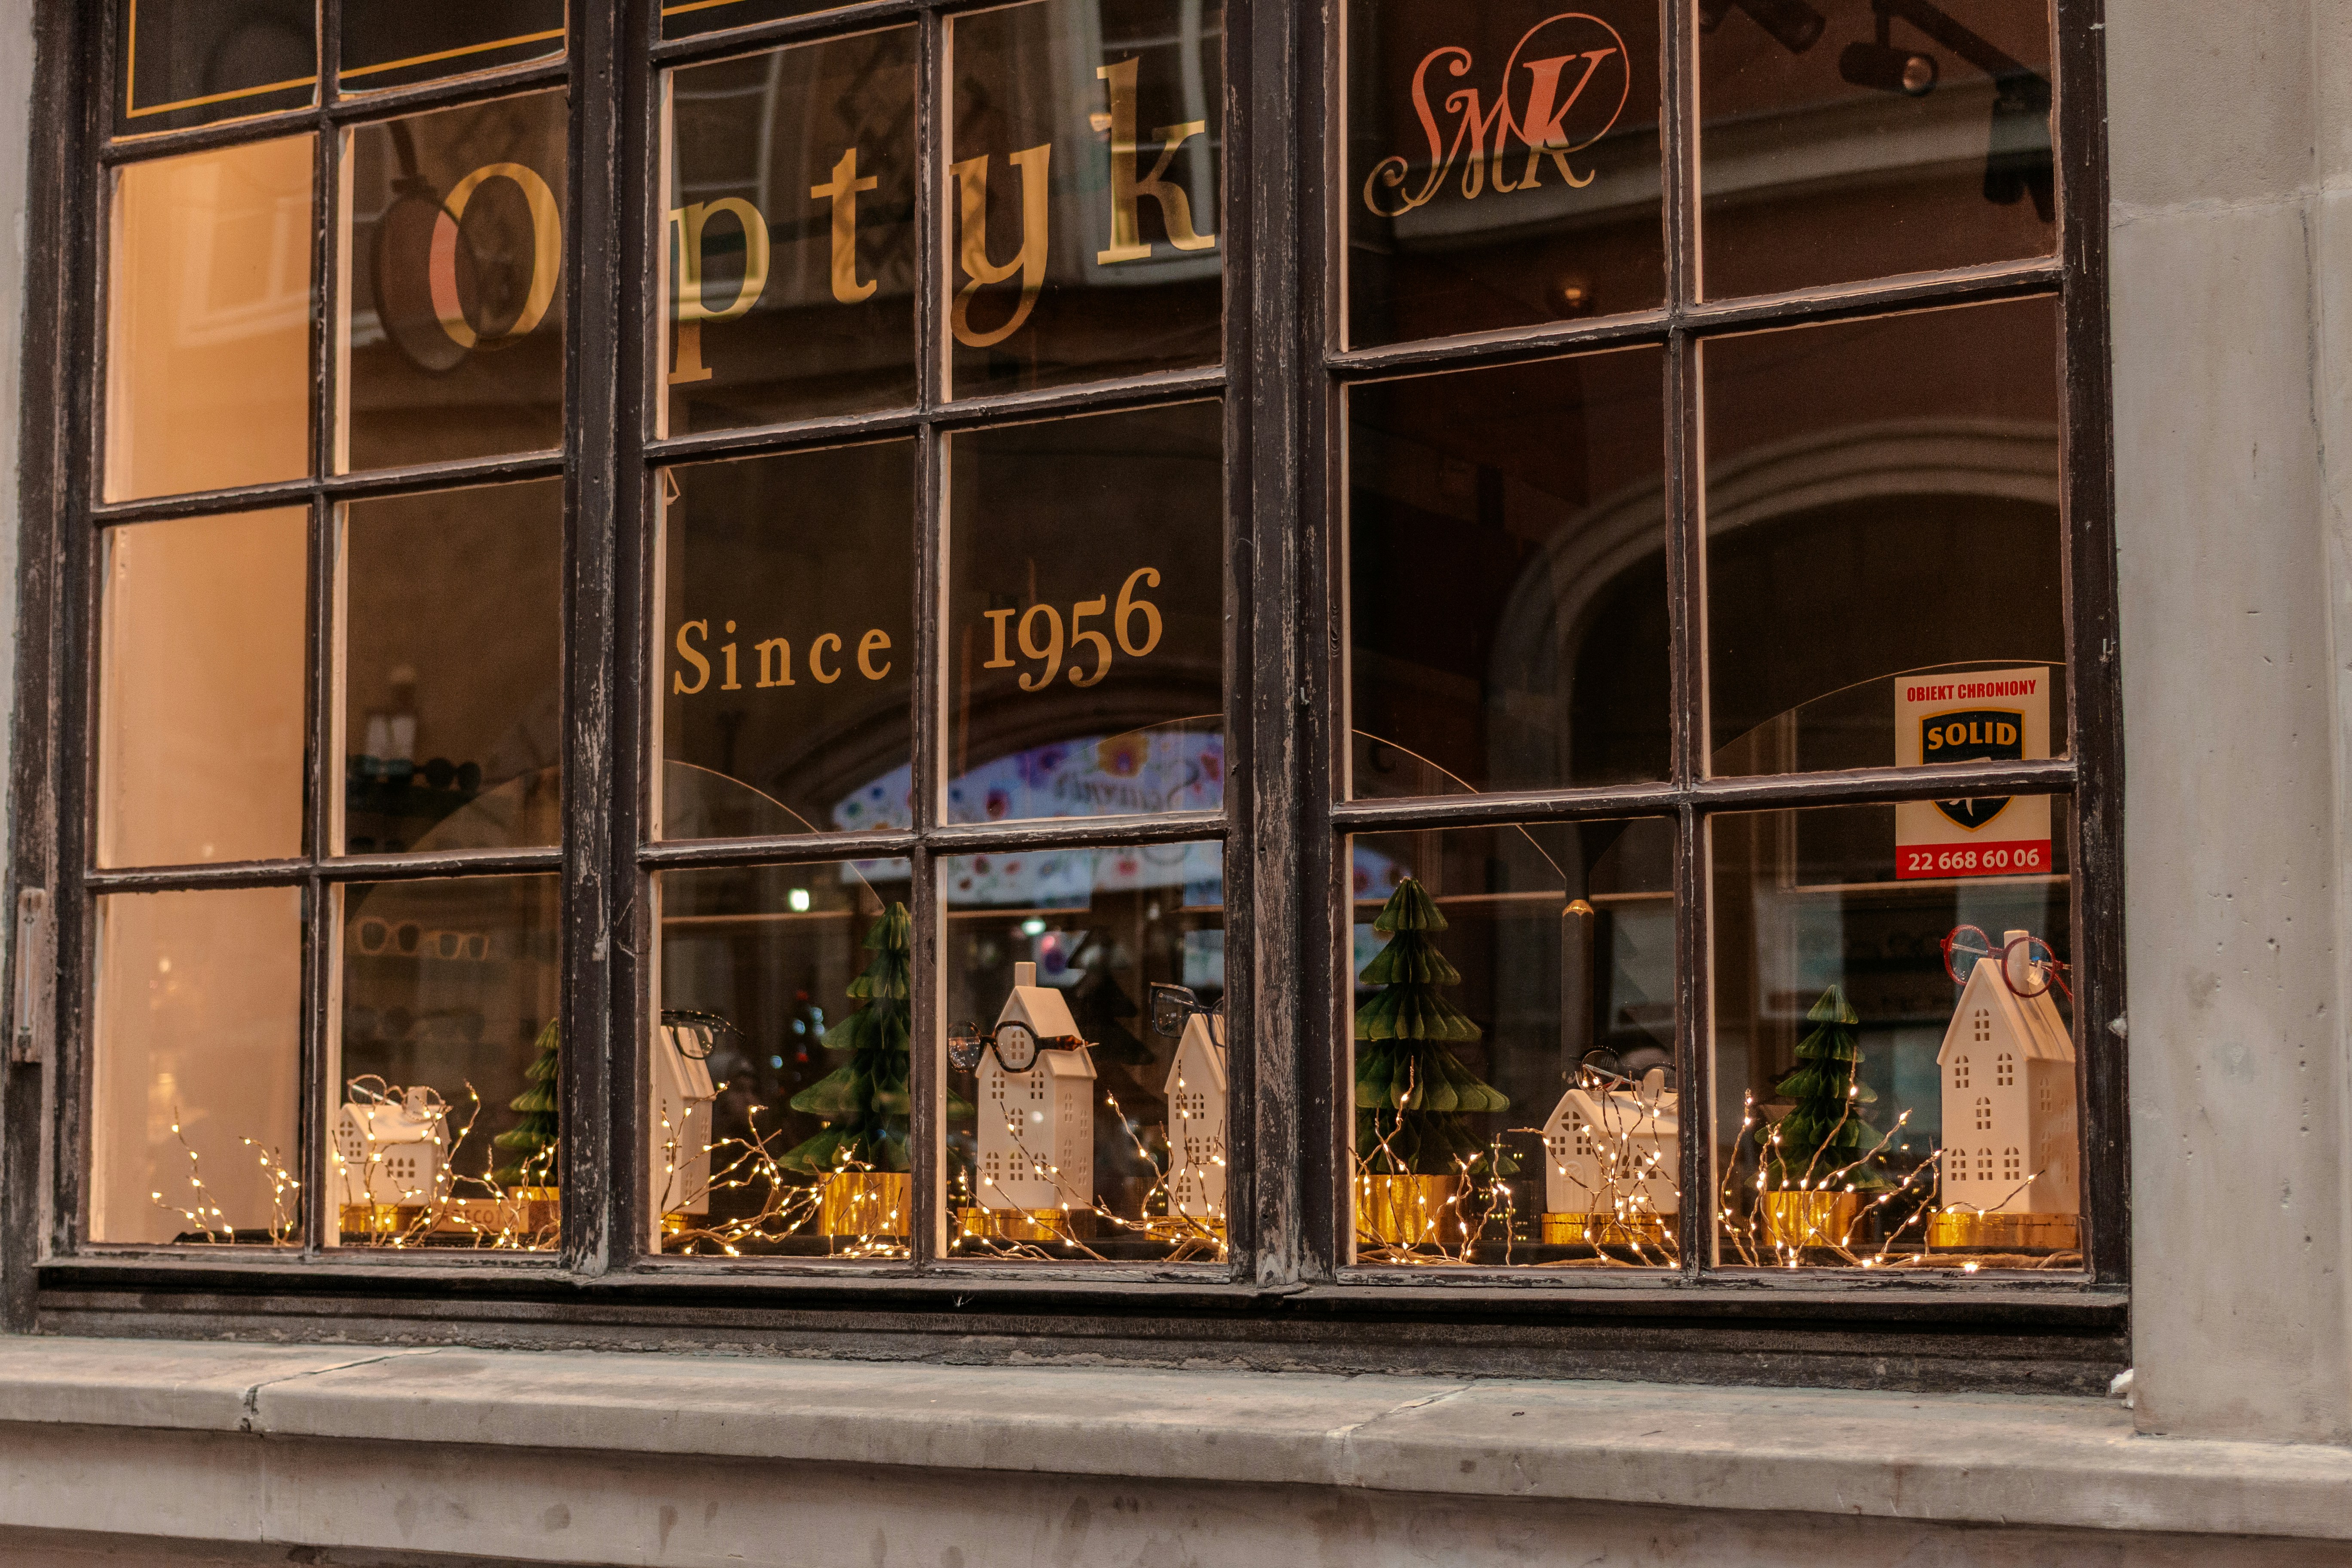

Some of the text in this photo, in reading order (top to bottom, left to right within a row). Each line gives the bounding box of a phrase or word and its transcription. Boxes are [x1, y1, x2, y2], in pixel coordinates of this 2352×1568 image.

[430, 56, 1215, 385] Optyk
[674, 567, 1163, 695] Since 1956
[1907, 680, 2037, 702] OBIEKT CHRONIONY
[1928, 721, 2017, 750] SOLID
[1908, 848, 2040, 871] 22 668 60 06
